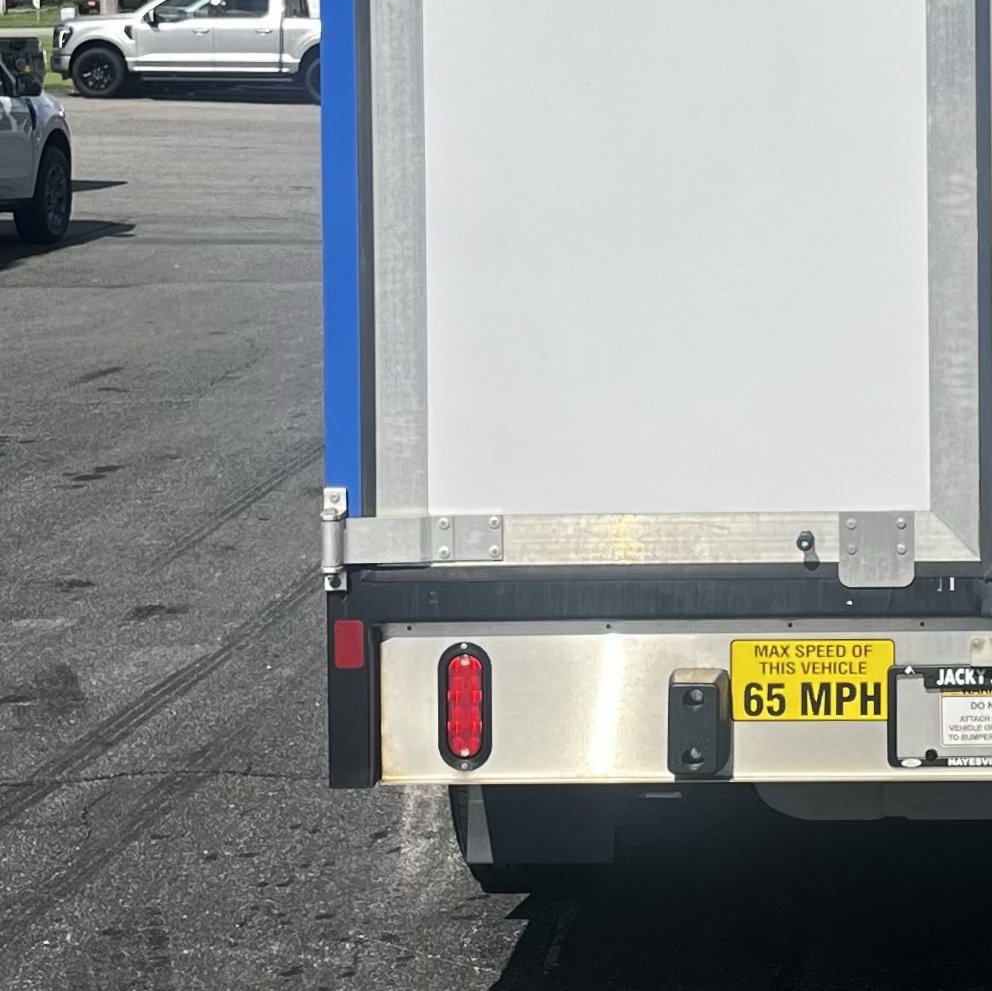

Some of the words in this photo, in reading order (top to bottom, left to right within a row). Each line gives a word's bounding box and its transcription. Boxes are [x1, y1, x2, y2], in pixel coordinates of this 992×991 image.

[754, 644, 790, 658] MAX
[795, 644, 846, 658] SPEED
[851, 644, 873, 658] OF
[759, 661, 796, 675] THIS
[801, 661, 868, 675] VEHICLE
[936, 667, 986, 686] JACKY
[743, 682, 786, 717] 65
[800, 682, 882, 716] MPH
[970, 701, 985, 710] DO
[949, 724, 981, 732] VEHICLE
